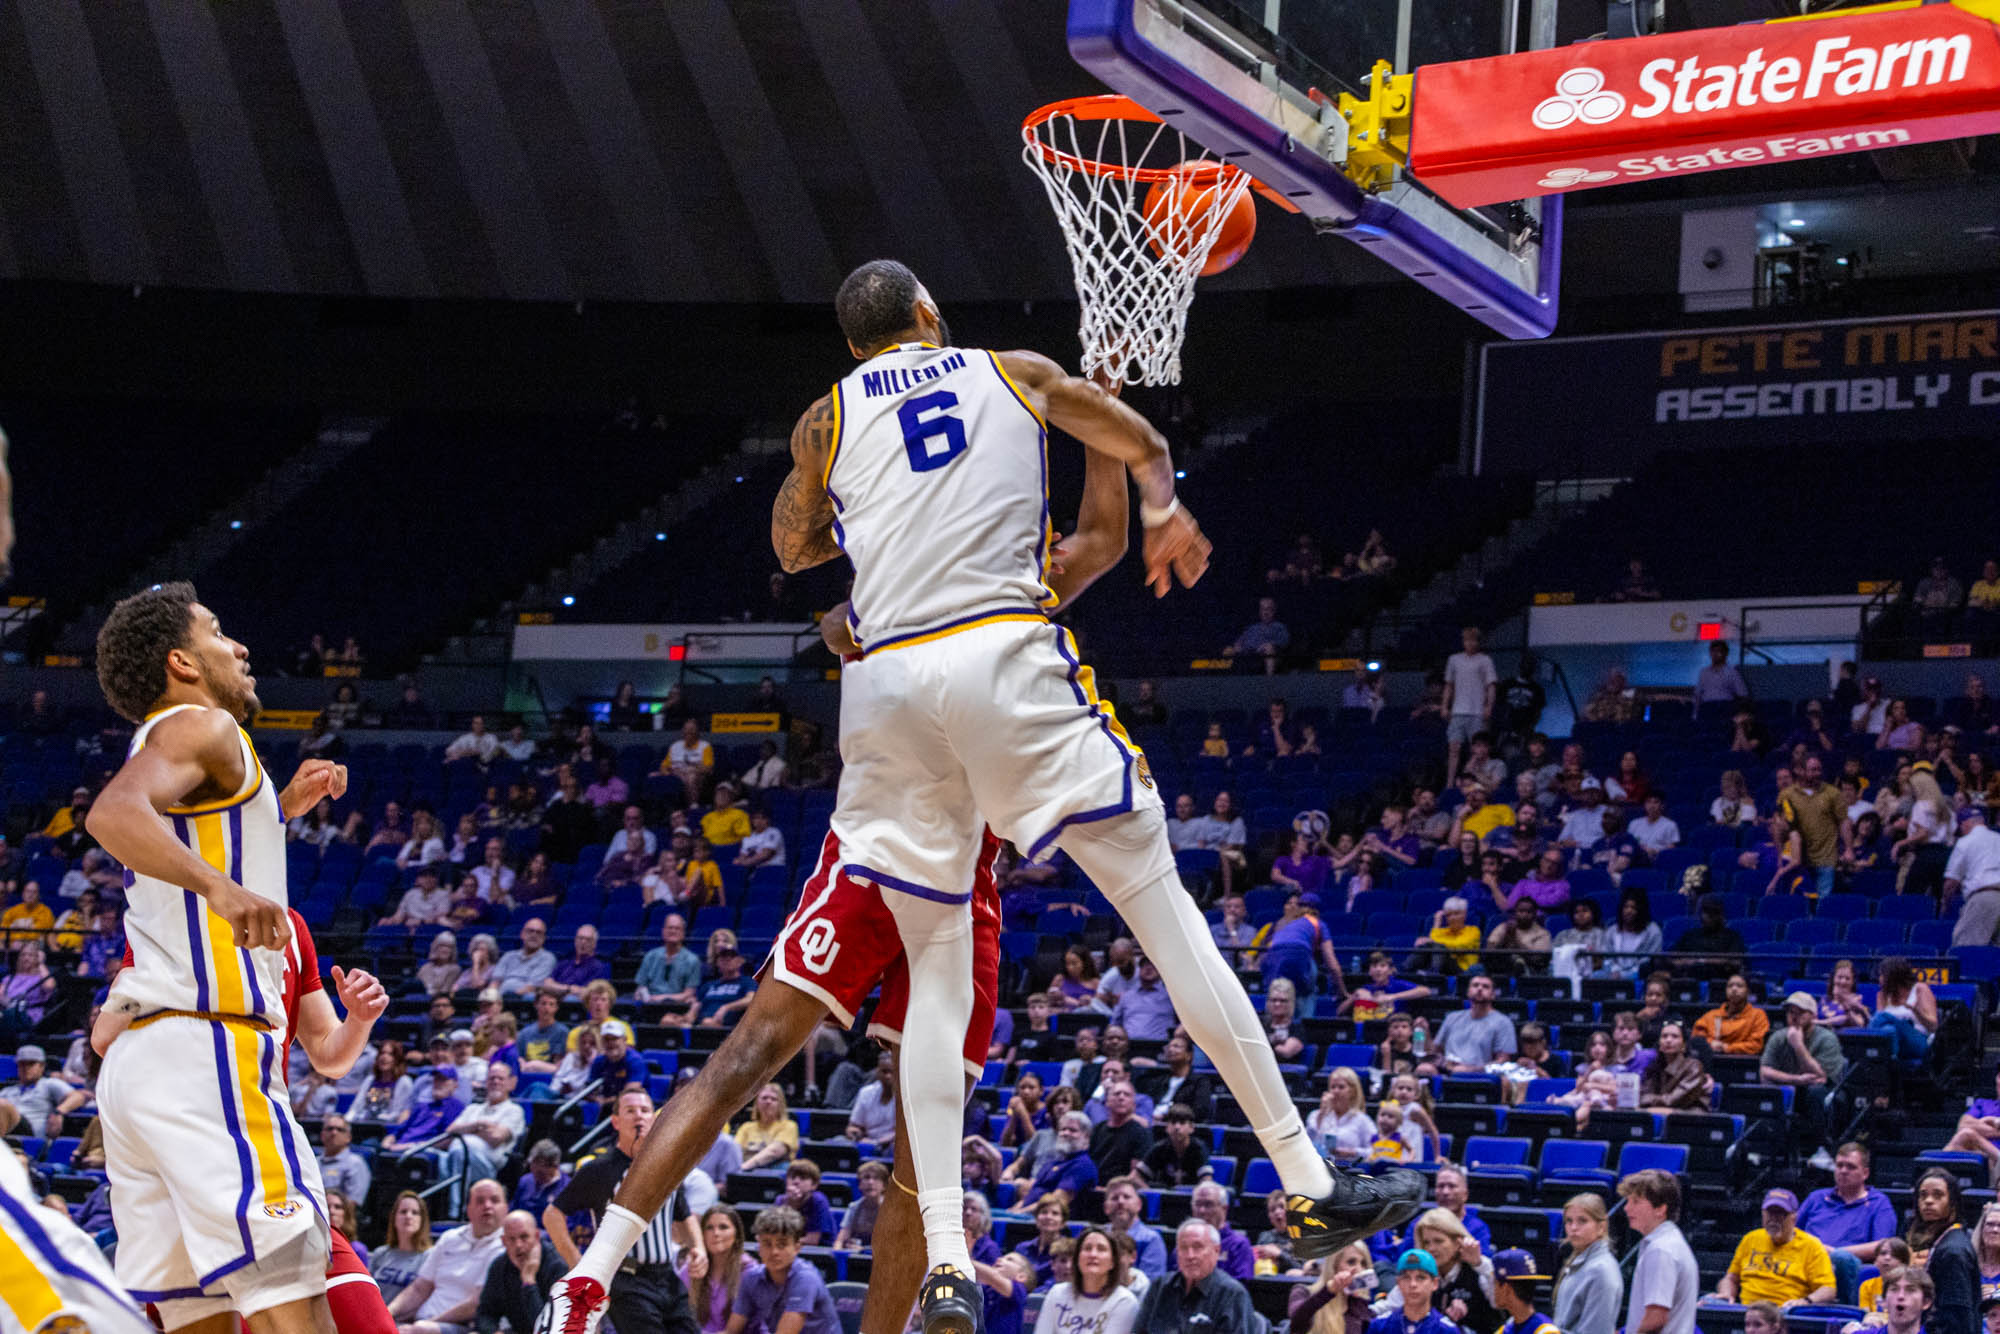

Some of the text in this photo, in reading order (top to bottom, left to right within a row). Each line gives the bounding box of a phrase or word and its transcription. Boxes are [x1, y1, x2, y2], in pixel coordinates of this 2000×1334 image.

[1631, 33, 1973, 119] State Farm
[1617, 127, 1911, 177] State Farm
[1659, 329, 1824, 378] PETE
[862, 365, 941, 399] MILLER
[1655, 373, 1952, 424] ASSEMBLY
[897, 390, 968, 473] 6
[799, 917, 841, 976] OU
[1914, 968, 1942, 985] 04
[1748, 1249, 1792, 1276] LSU
